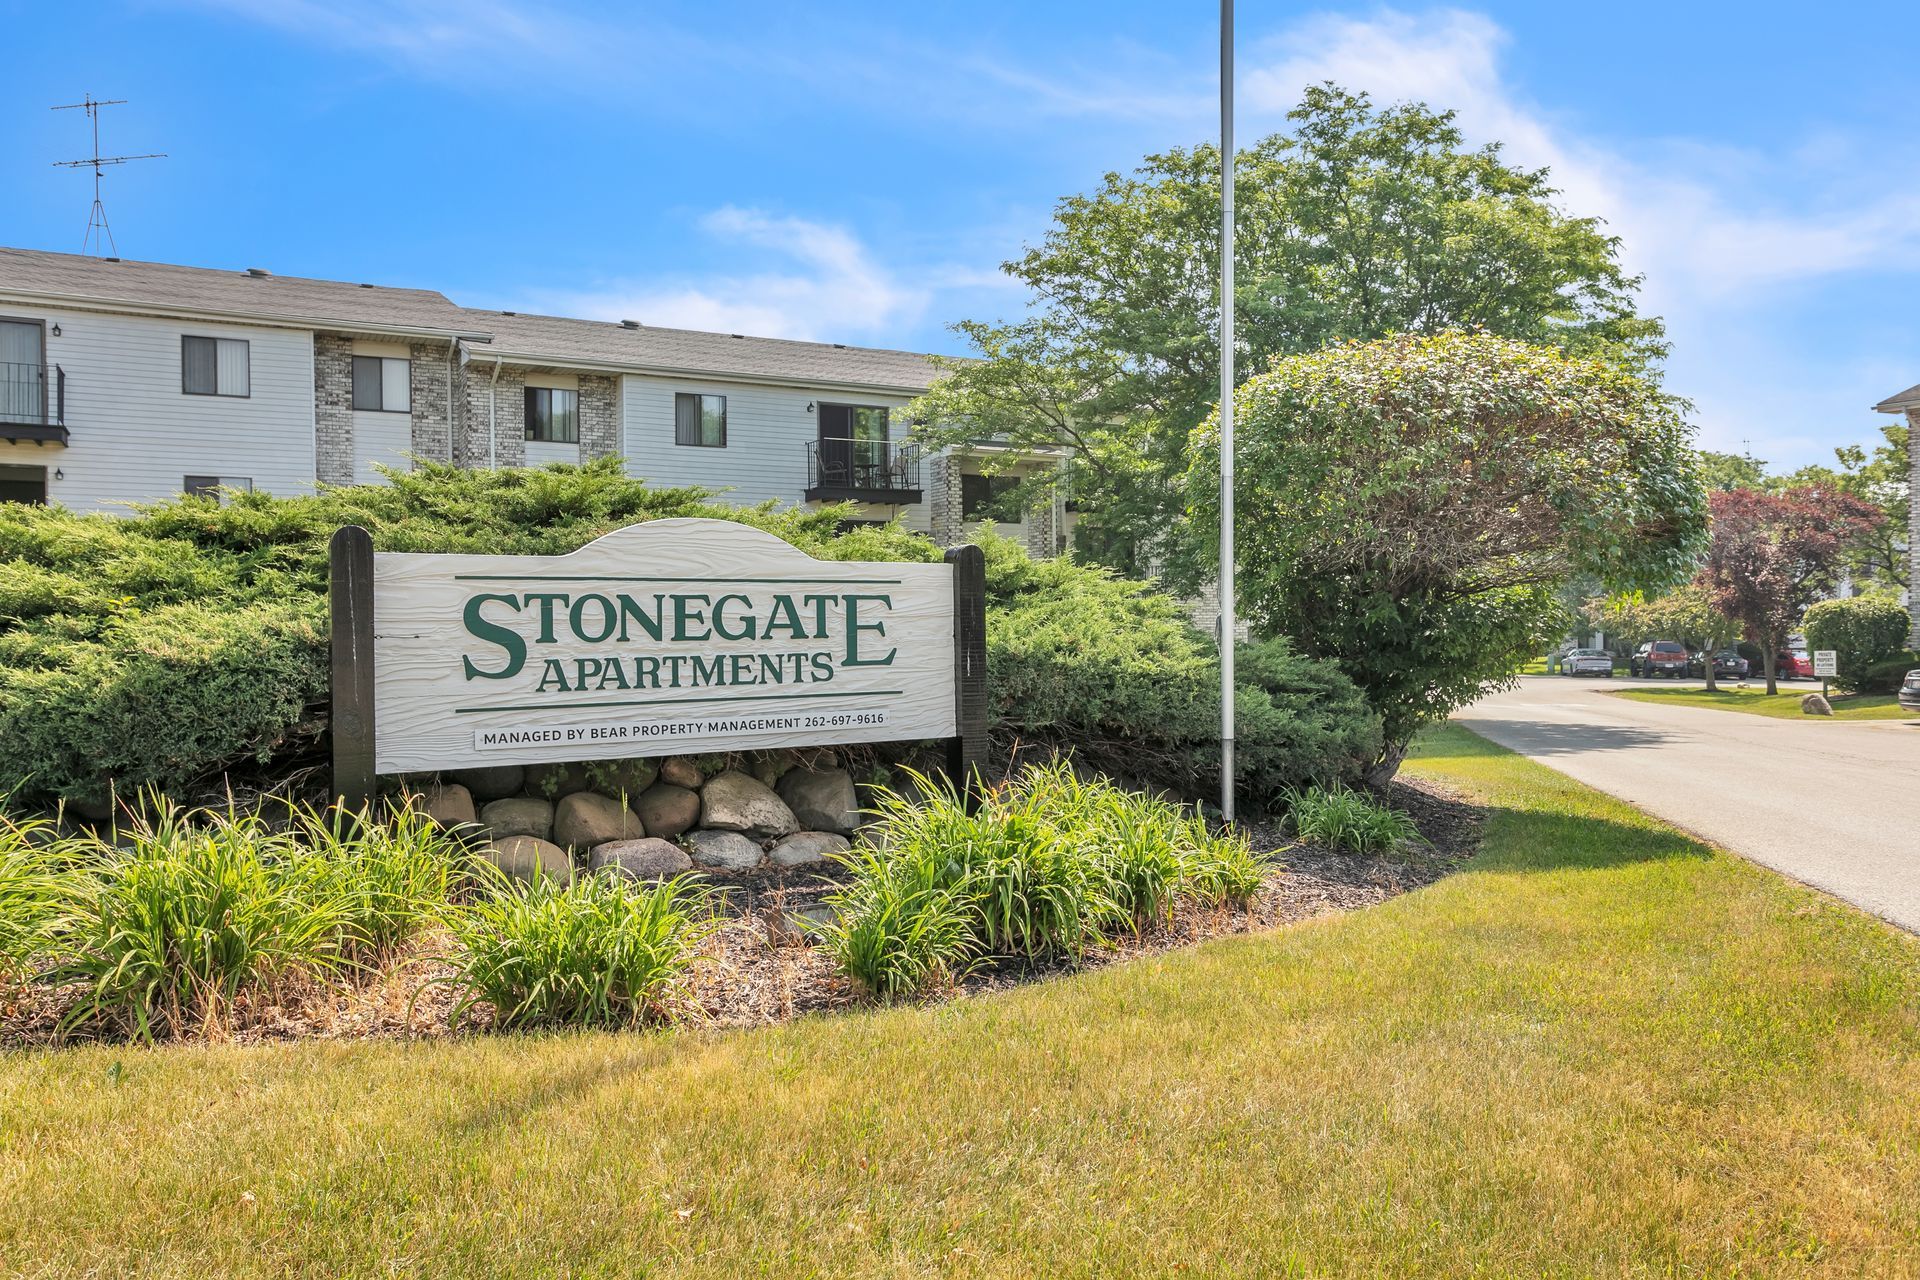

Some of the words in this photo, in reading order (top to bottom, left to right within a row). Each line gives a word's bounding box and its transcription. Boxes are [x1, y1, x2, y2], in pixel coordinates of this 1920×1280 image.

[462, 592, 898, 681] STONEGATE
[535, 652, 834, 692] APARTMENTS
[484, 730, 562, 745] MANAGED
[567, 728, 585, 740] BY
[590, 726, 628, 739] BEAR
[632, 722, 704, 737] PROPERTY
[708, 717, 801, 733] MANAGEMENT
[804, 713, 885, 728] 262-697-9616
